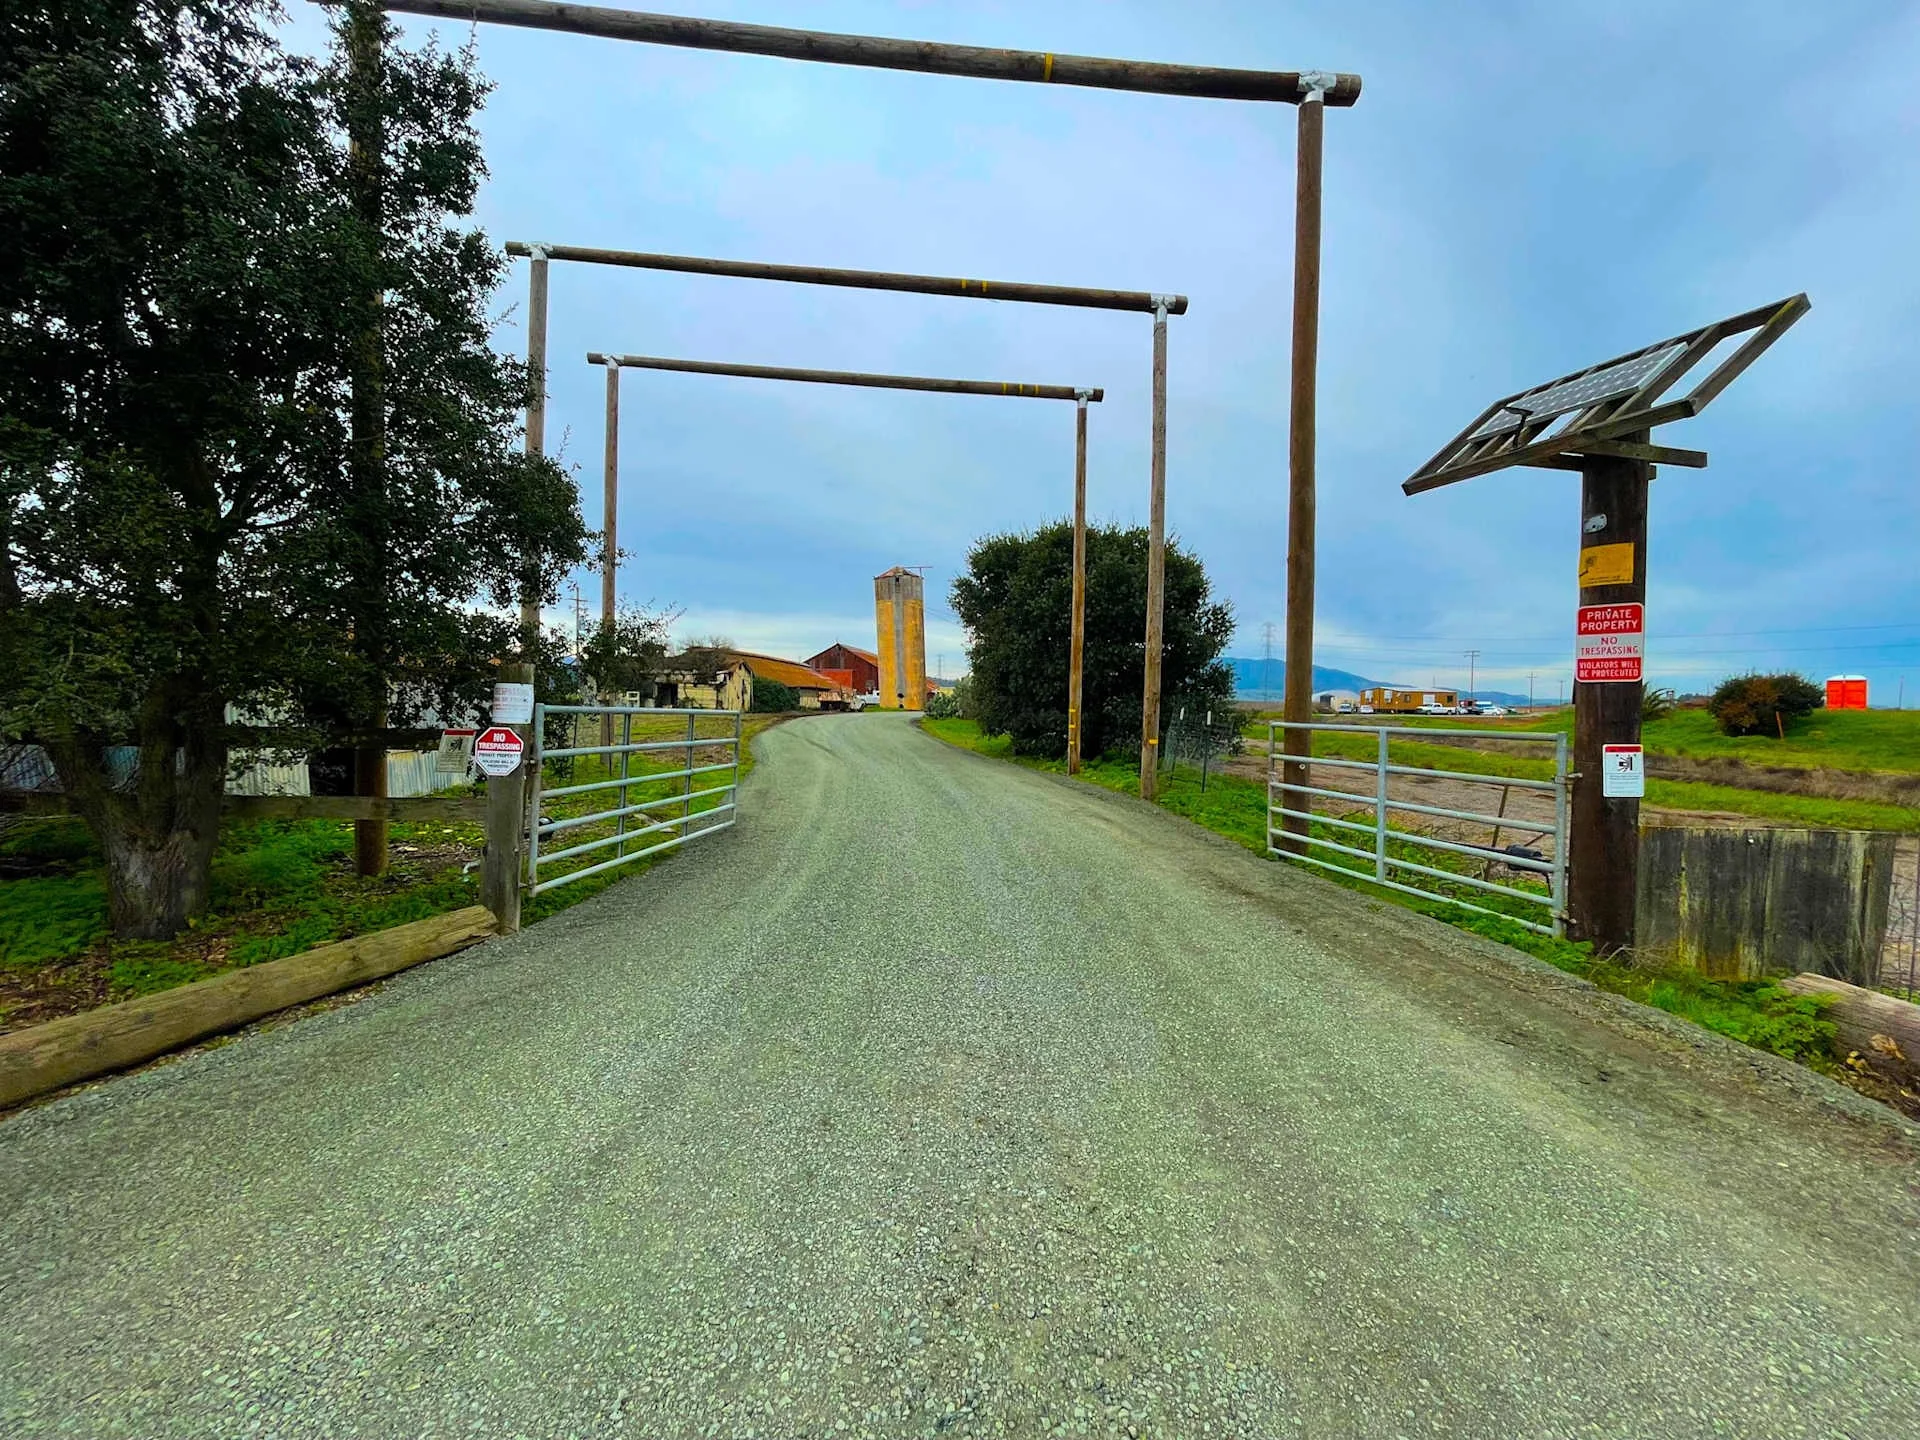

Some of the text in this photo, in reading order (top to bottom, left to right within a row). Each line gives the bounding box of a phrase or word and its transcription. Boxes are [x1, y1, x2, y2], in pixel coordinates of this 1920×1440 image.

[1587, 609, 1632, 620] PRIVATE
[1580, 620, 1638, 631] PROPERTY
[1601, 636, 1618, 645] NO
[1581, 646, 1639, 656] TRESPASSING
[1579, 660, 1639, 669] VIOLATORS WILL
[1579, 669, 1589, 677] BE
[493, 733, 505, 742] NO
[478, 742, 520, 750] TRESPASSING
